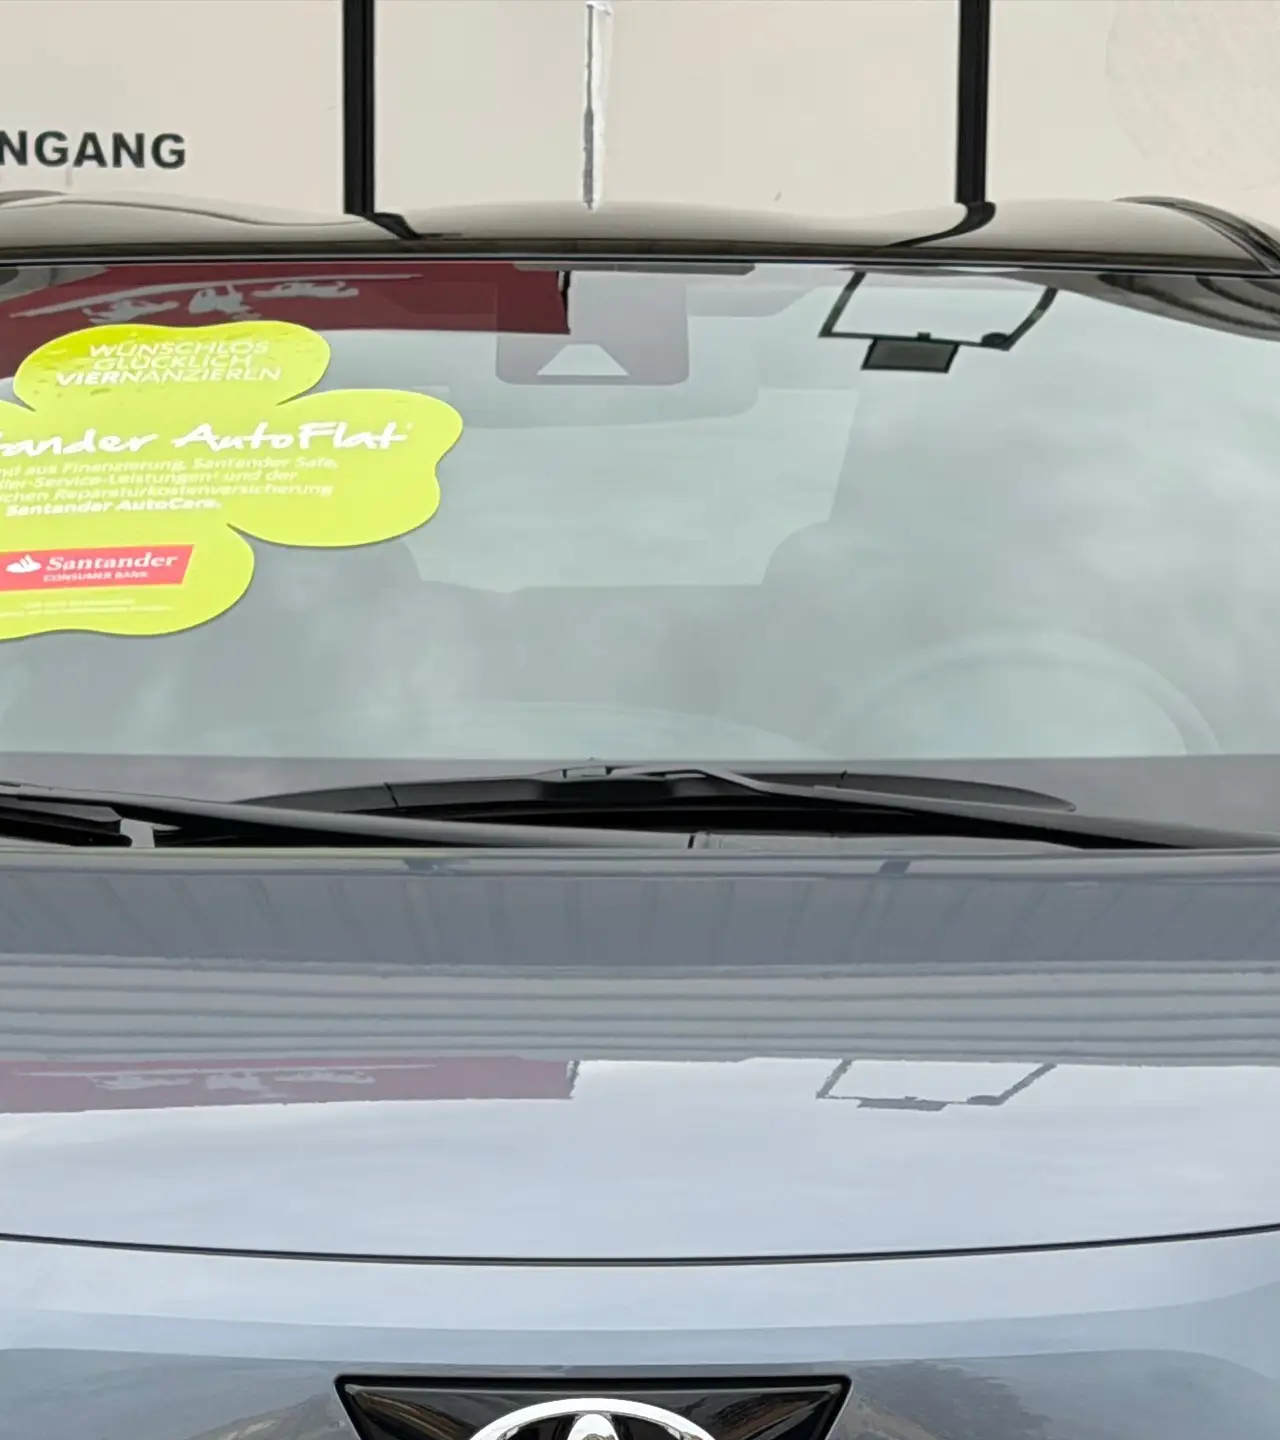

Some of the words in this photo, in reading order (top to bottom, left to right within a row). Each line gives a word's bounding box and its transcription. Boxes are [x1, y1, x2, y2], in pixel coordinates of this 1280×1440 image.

[89, 338, 269, 357] WÜNSCHLOS
[93, 354, 253, 371] GLÜCKLICH
[24, 464, 57, 476] aus
[192, 457, 290, 470] Santander
[223, 469, 261, 482] und
[265, 469, 298, 482] der
[6, 500, 112, 517] Santander
[45, 551, 179, 572] Santander
[43, 572, 114, 583] CONSUMER
[115, 570, 149, 580] BANK
